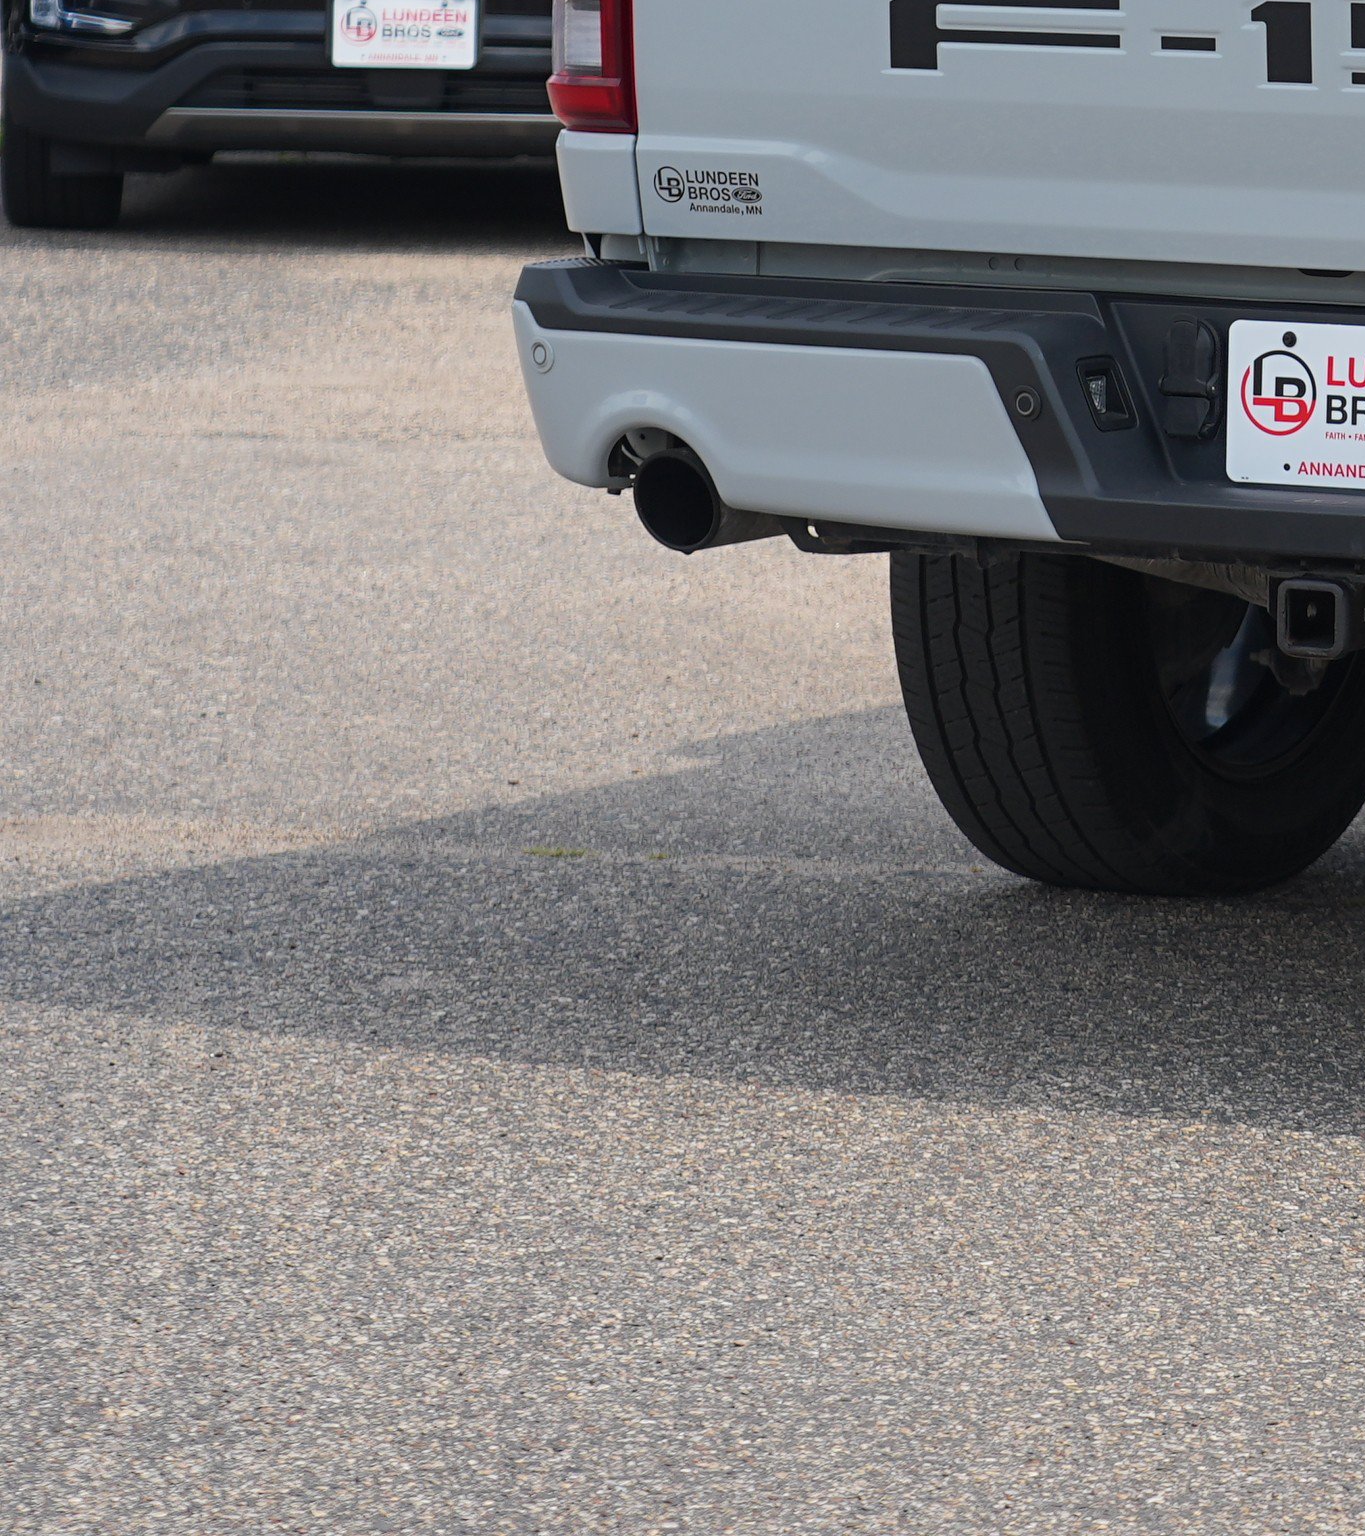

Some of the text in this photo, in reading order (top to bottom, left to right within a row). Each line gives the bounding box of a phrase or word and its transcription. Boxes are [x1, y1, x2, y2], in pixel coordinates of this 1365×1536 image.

[382, 8, 467, 23] LUNDEEN
[382, 24, 432, 38] BROS
[685, 170, 759, 187] LUNDEEN
[688, 186, 731, 201] BROS
[690, 203, 762, 215] Annandale, MN
[1325, 431, 1346, 440] FAITH
